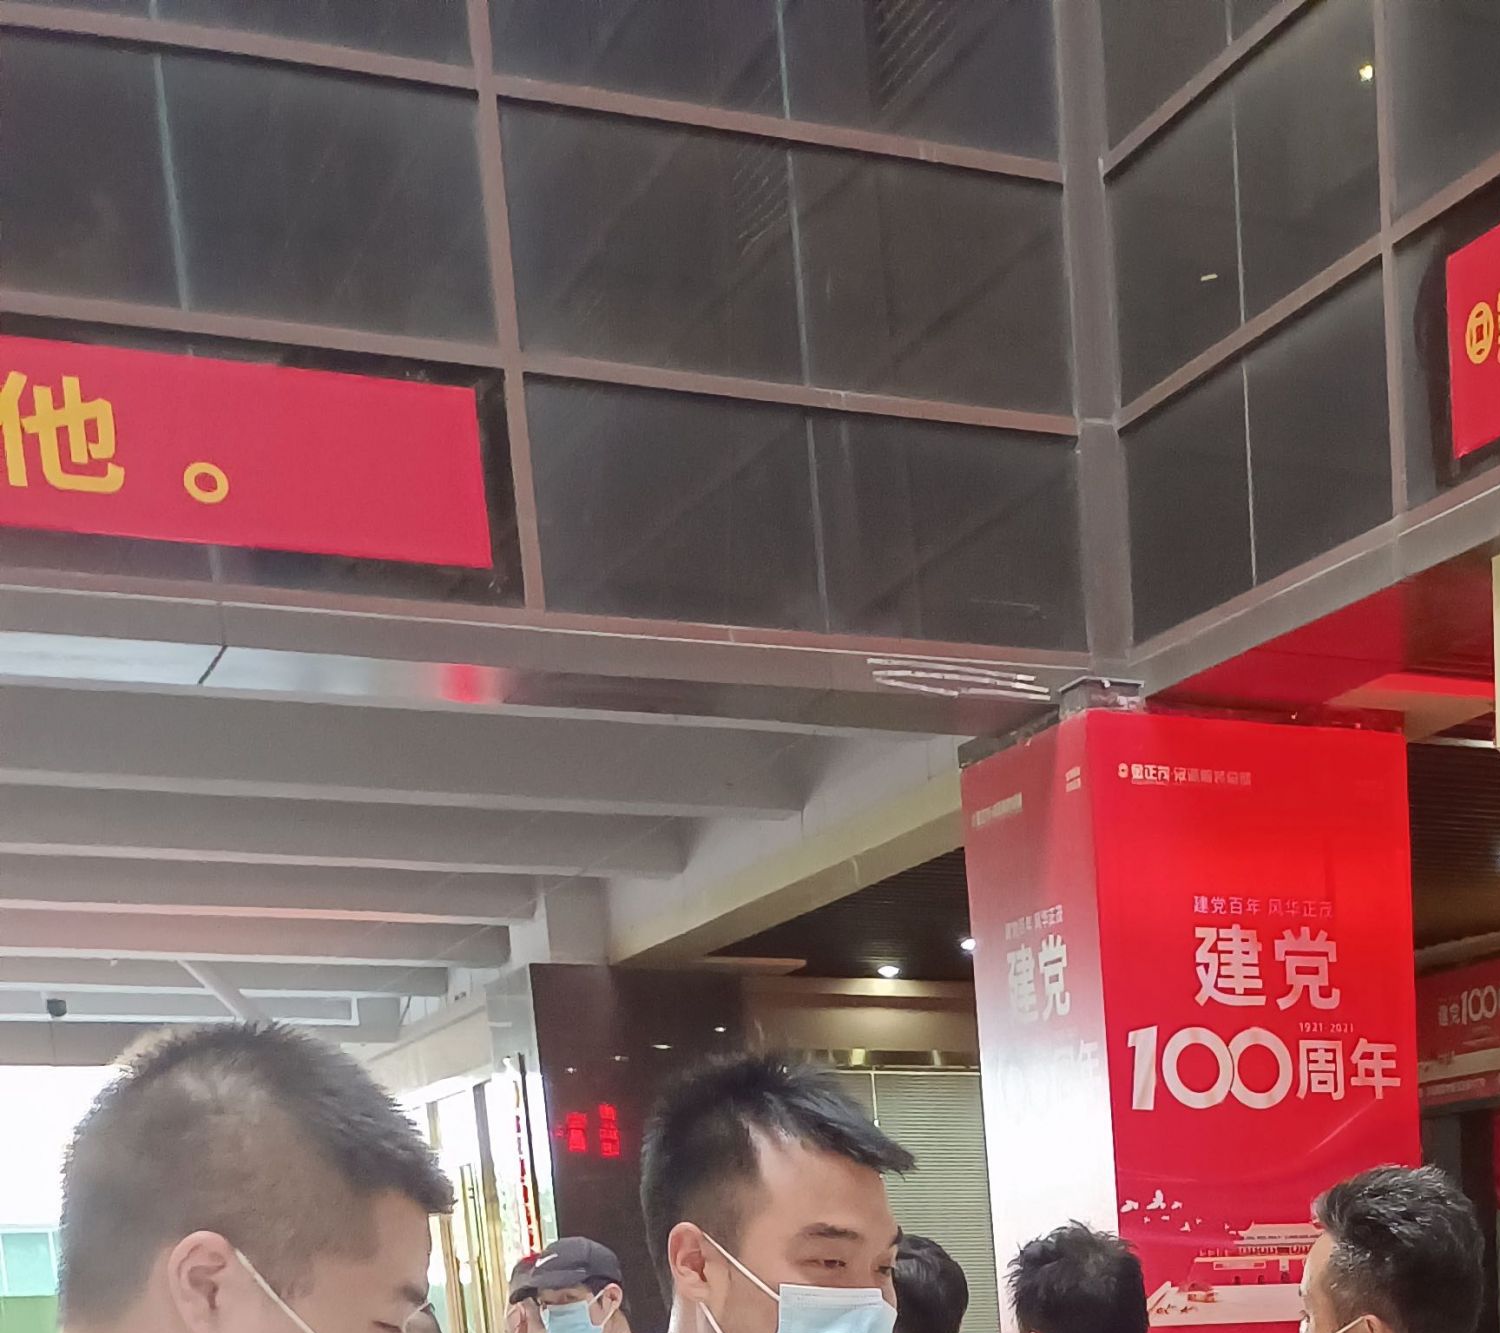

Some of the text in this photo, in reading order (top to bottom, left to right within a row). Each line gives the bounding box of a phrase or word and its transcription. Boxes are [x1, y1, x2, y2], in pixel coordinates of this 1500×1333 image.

[1193, 895, 1261, 916] 建党百年
[1195, 924, 1341, 1011] 建党
[1127, 1025, 1401, 1111] 100周年
